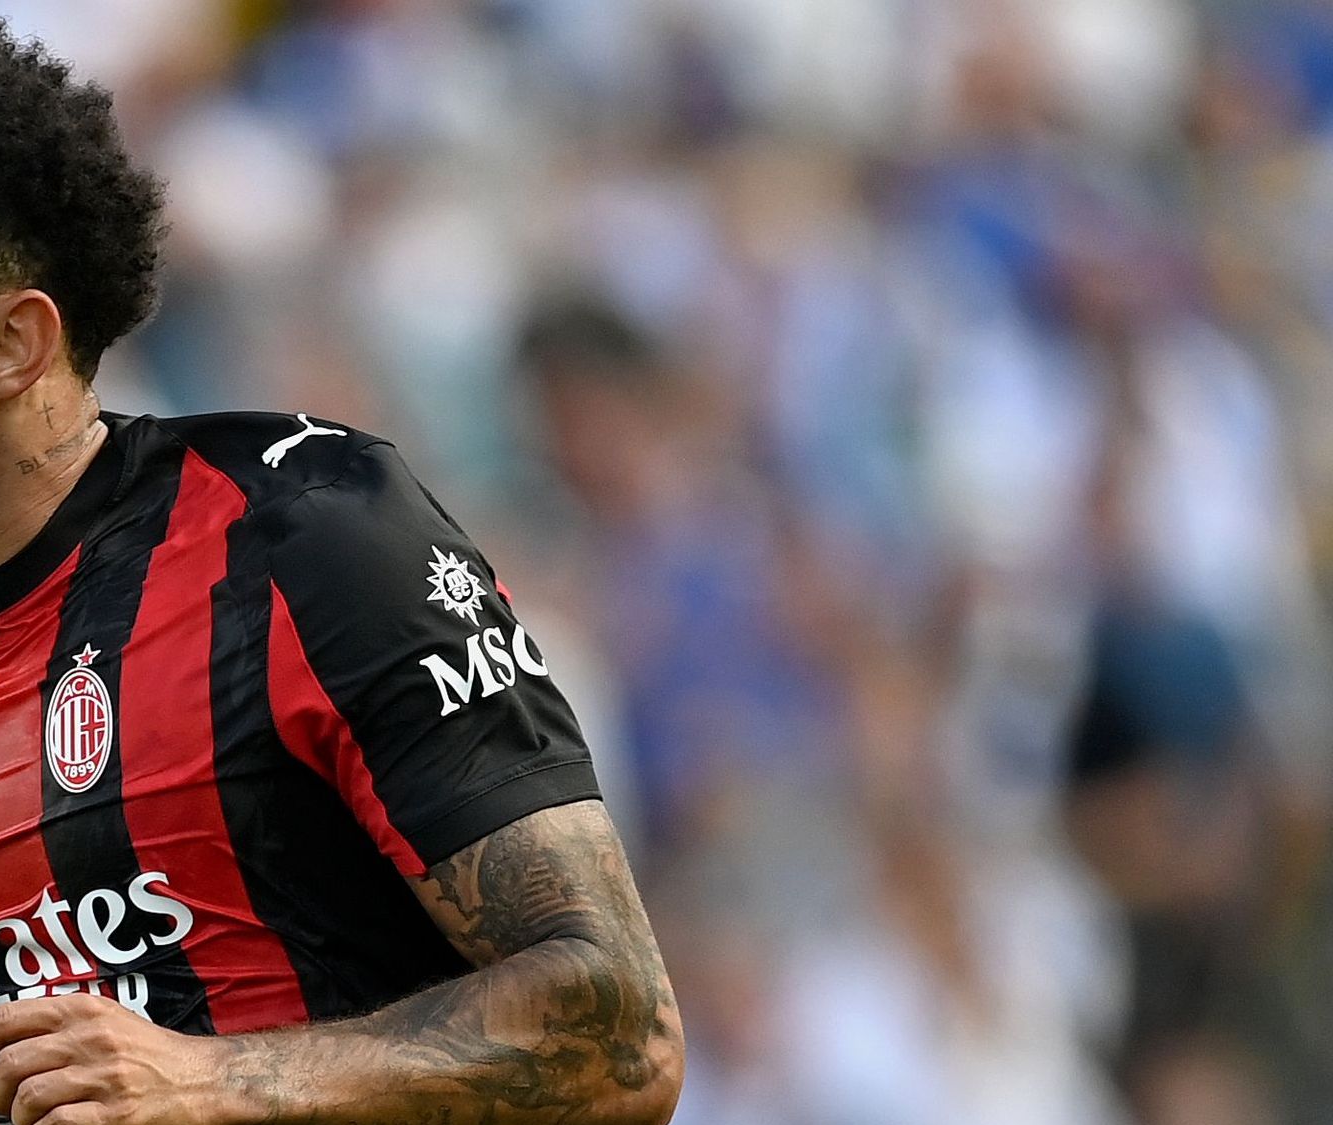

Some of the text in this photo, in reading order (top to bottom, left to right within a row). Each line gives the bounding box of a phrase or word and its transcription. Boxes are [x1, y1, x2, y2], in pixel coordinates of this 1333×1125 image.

[419, 623, 549, 717] MSC
[60, 677, 98, 704] ACM
[63, 762, 96, 779] 1899
